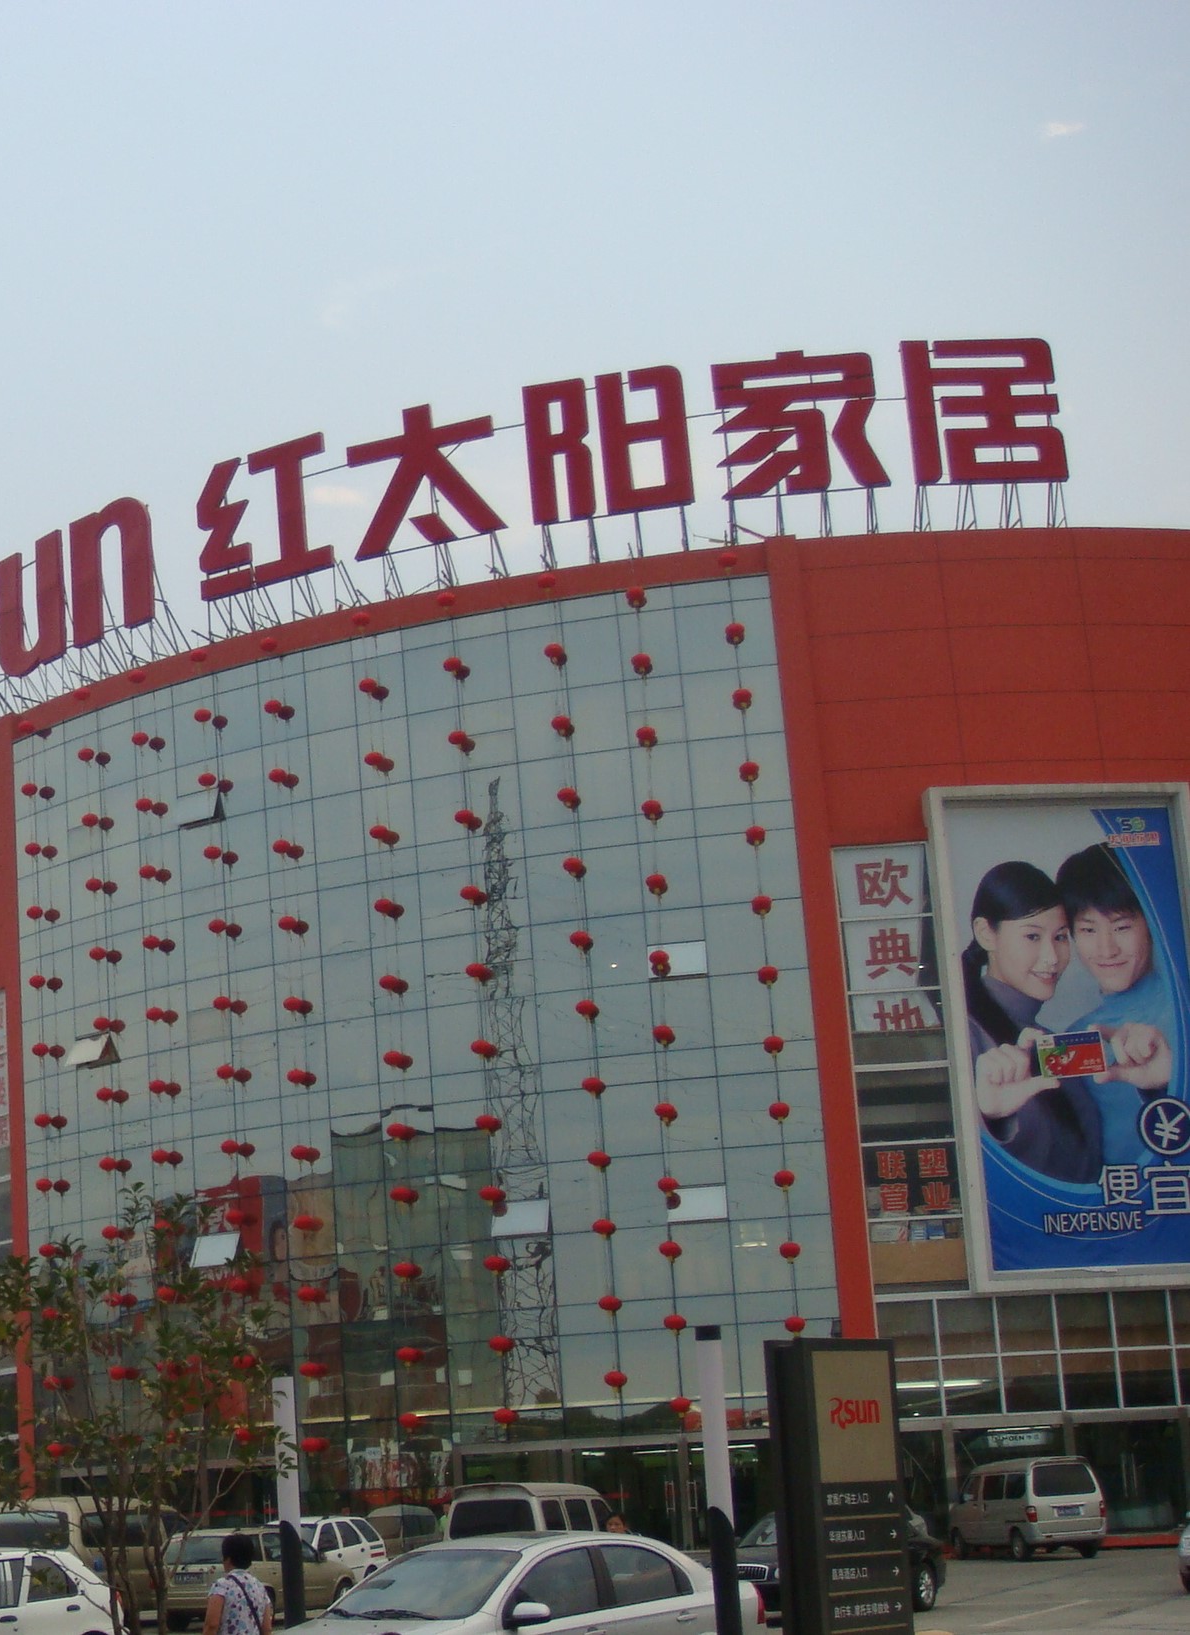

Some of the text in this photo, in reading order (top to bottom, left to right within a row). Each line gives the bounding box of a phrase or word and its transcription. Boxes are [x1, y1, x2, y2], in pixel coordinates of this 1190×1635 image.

[197, 337, 1069, 602] 红太阳家居
[1098, 1160, 1190, 1216] 便宜
[1043, 1210, 1143, 1234] INEXPENSIVE
